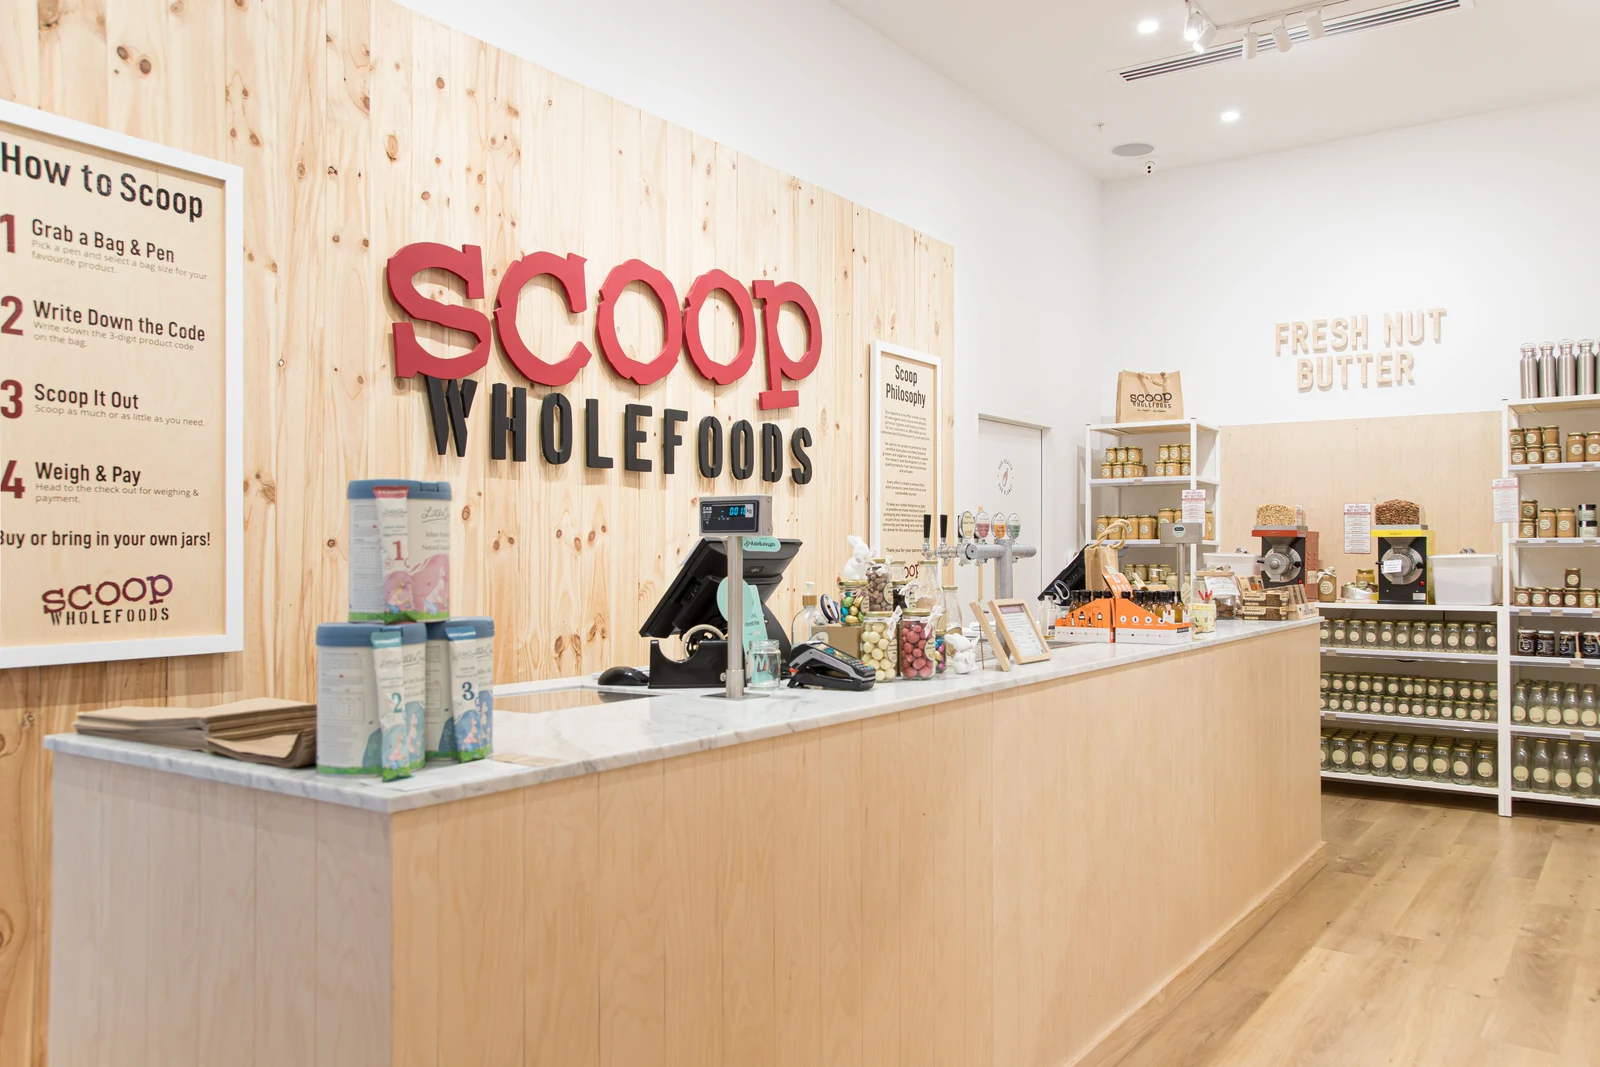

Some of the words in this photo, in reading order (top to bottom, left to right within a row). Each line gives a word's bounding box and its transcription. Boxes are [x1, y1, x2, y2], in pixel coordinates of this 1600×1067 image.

[1, 141, 71, 188] How
[81, 164, 112, 197] to
[120, 172, 203, 223] Scoop
[0, 213, 17, 254] 1
[32, 218, 73, 242] Grab
[79, 232, 88, 246] a
[94, 231, 124, 256] Bag
[130, 239, 141, 256] &
[146, 241, 175, 263] Pen
[32, 250, 76, 266] favourite
[32, 239, 52, 250] Pick
[62, 247, 81, 257] pen
[84, 250, 101, 260] and
[104, 254, 130, 265] select
[139, 261, 156, 272] bag
[157, 264, 174, 274] size
[175, 266, 187, 276] for
[189, 271, 208, 280] your
[1, 295, 24, 336] 2
[33, 299, 82, 324] Write
[88, 308, 133, 332] Down
[138, 317, 164, 336] the
[168, 321, 206, 341] Code
[33, 320, 60, 332] Write
[62, 325, 89, 336] down
[91, 330, 107, 339] the
[109, 331, 137, 344] 3-digit
[139, 337, 173, 348] product
[174, 341, 194, 351] code
[33, 333, 47, 341] on
[49, 334, 65, 344] the
[1275, 314, 1368, 357] FRESH
[1383, 307, 1447, 348] NUT
[895, 364, 918, 387] Scoop
[1297, 350, 1415, 394] BUTTER
[0, 379, 23, 420] 3
[34, 383, 88, 409] Scoop
[94, 389, 106, 407] It
[111, 391, 139, 410] Out
[885, 382, 926, 409] Philosophy
[35, 403, 65, 416] Scoop
[67, 408, 78, 416] as
[80, 409, 106, 418] much
[108, 411, 119, 419] or
[133, 412, 152, 422] little
[153, 415, 164, 423] as
[165, 417, 181, 425] you
[424, 373, 813, 485] WHOLEFOODS
[0, 459, 26, 499] 4
[35, 461, 90, 484] Weigh
[95, 465, 107, 482] &
[112, 465, 141, 487] Pay
[35, 482, 62, 491] Head
[64, 484, 74, 492] to
[76, 484, 92, 493] the
[94, 485, 120, 494] check
[122, 486, 137, 494] out
[139, 486, 152, 495] for
[153, 487, 191, 498] weighing
[192, 488, 200, 497] &
[0, 529, 26, 549] Buy
[31, 533, 47, 546] or
[52, 530, 91, 549] bring
[96, 530, 109, 546] in
[113, 534, 146, 549] your
[149, 534, 178, 546] own
[180, 531, 211, 549] jars!
[391, 540, 405, 561] 1
[50, 606, 170, 626] WHOLEFOODS
[391, 692, 403, 713] 2
[461, 681, 475, 701] 3
